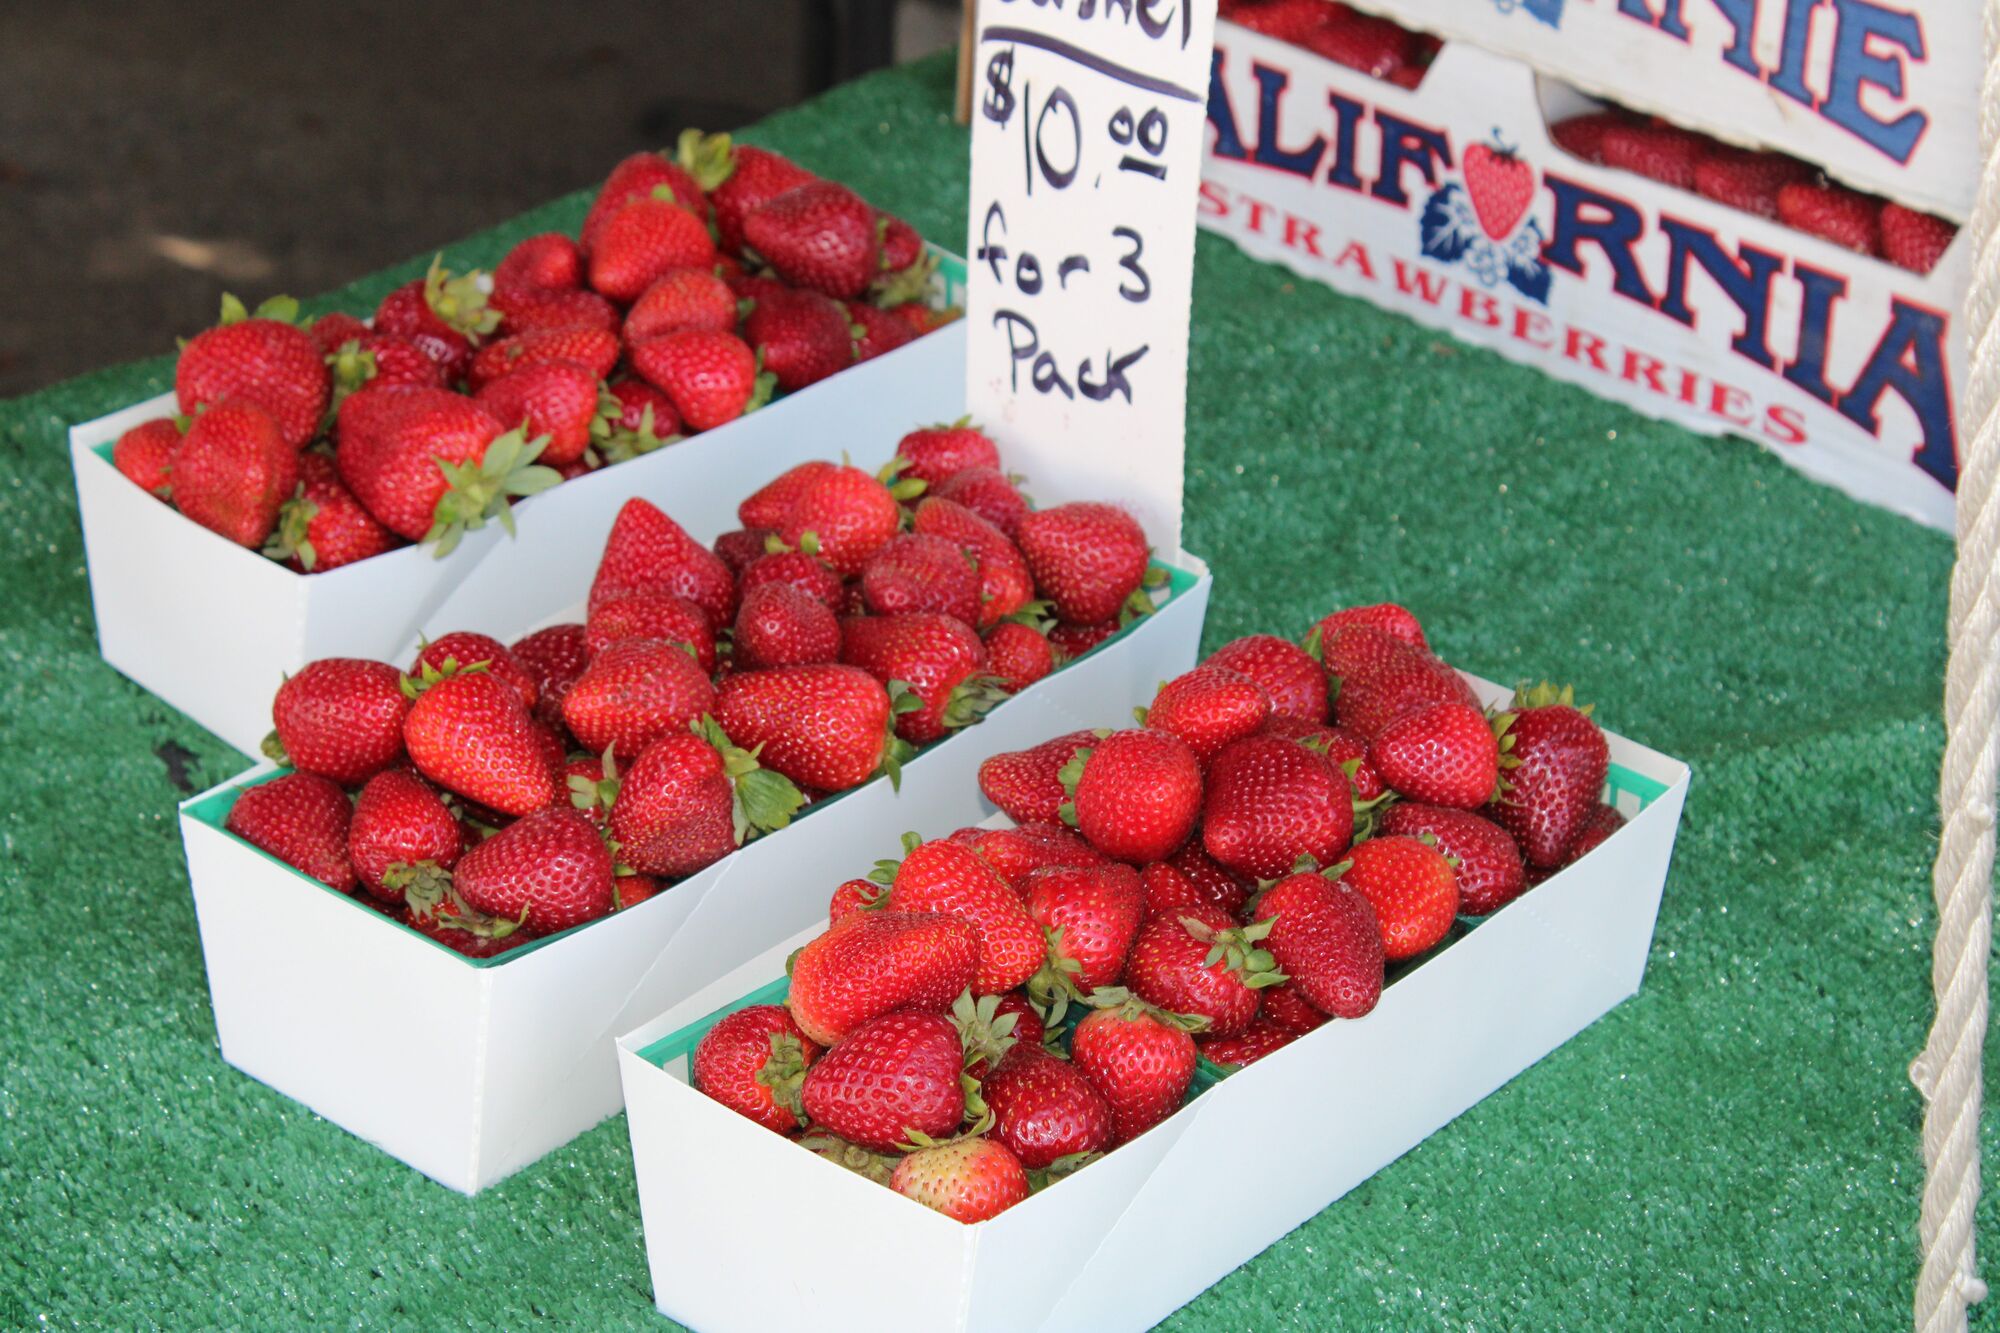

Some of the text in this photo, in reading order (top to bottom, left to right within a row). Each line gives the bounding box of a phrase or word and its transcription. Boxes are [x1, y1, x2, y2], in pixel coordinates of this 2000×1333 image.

[977, 200, 1152, 303] for 3
[992, 309, 1150, 404] Pack
[1198, 179, 1808, 444] STRAWBERRIES
